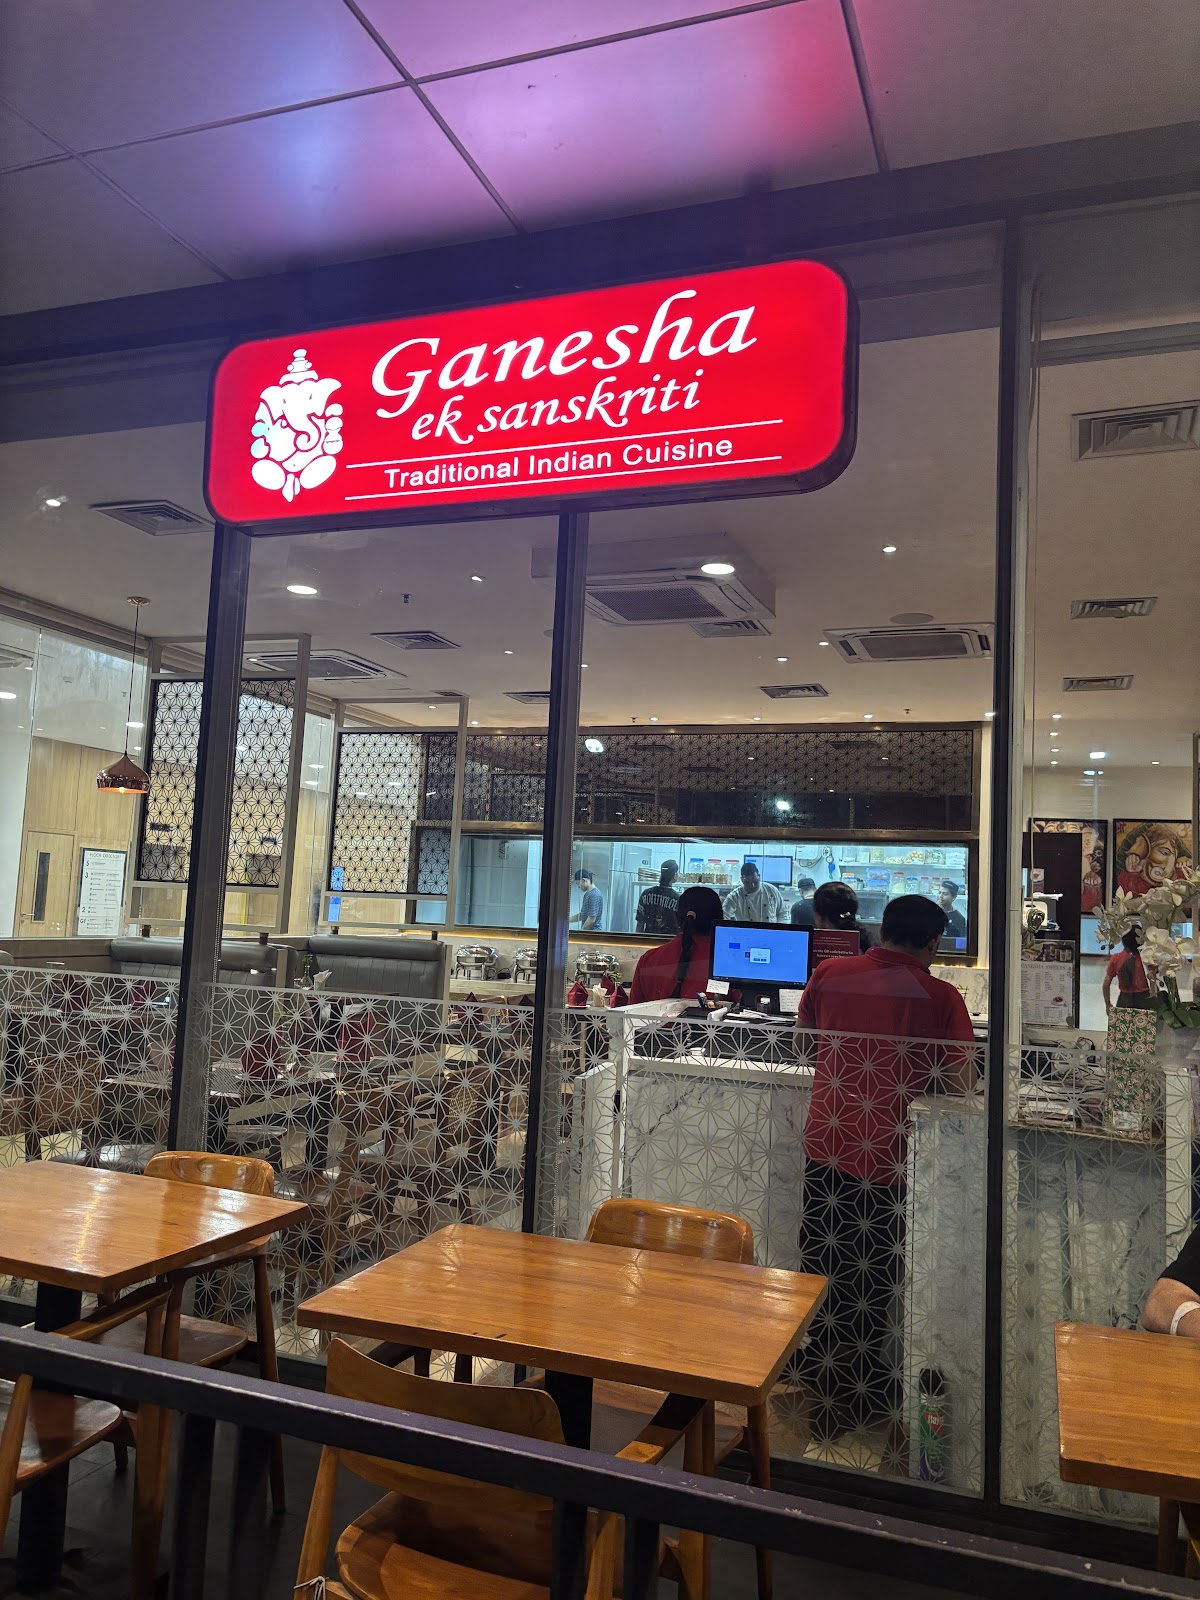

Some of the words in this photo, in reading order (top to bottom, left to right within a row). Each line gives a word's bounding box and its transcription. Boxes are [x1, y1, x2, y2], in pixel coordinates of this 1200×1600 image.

[371, 289, 758, 419] Ganesha
[411, 394, 474, 445] ek
[476, 368, 704, 432] sanskriti
[383, 454, 519, 489] Traditional
[529, 448, 612, 475] Indian
[622, 438, 733, 468] Cuisine
